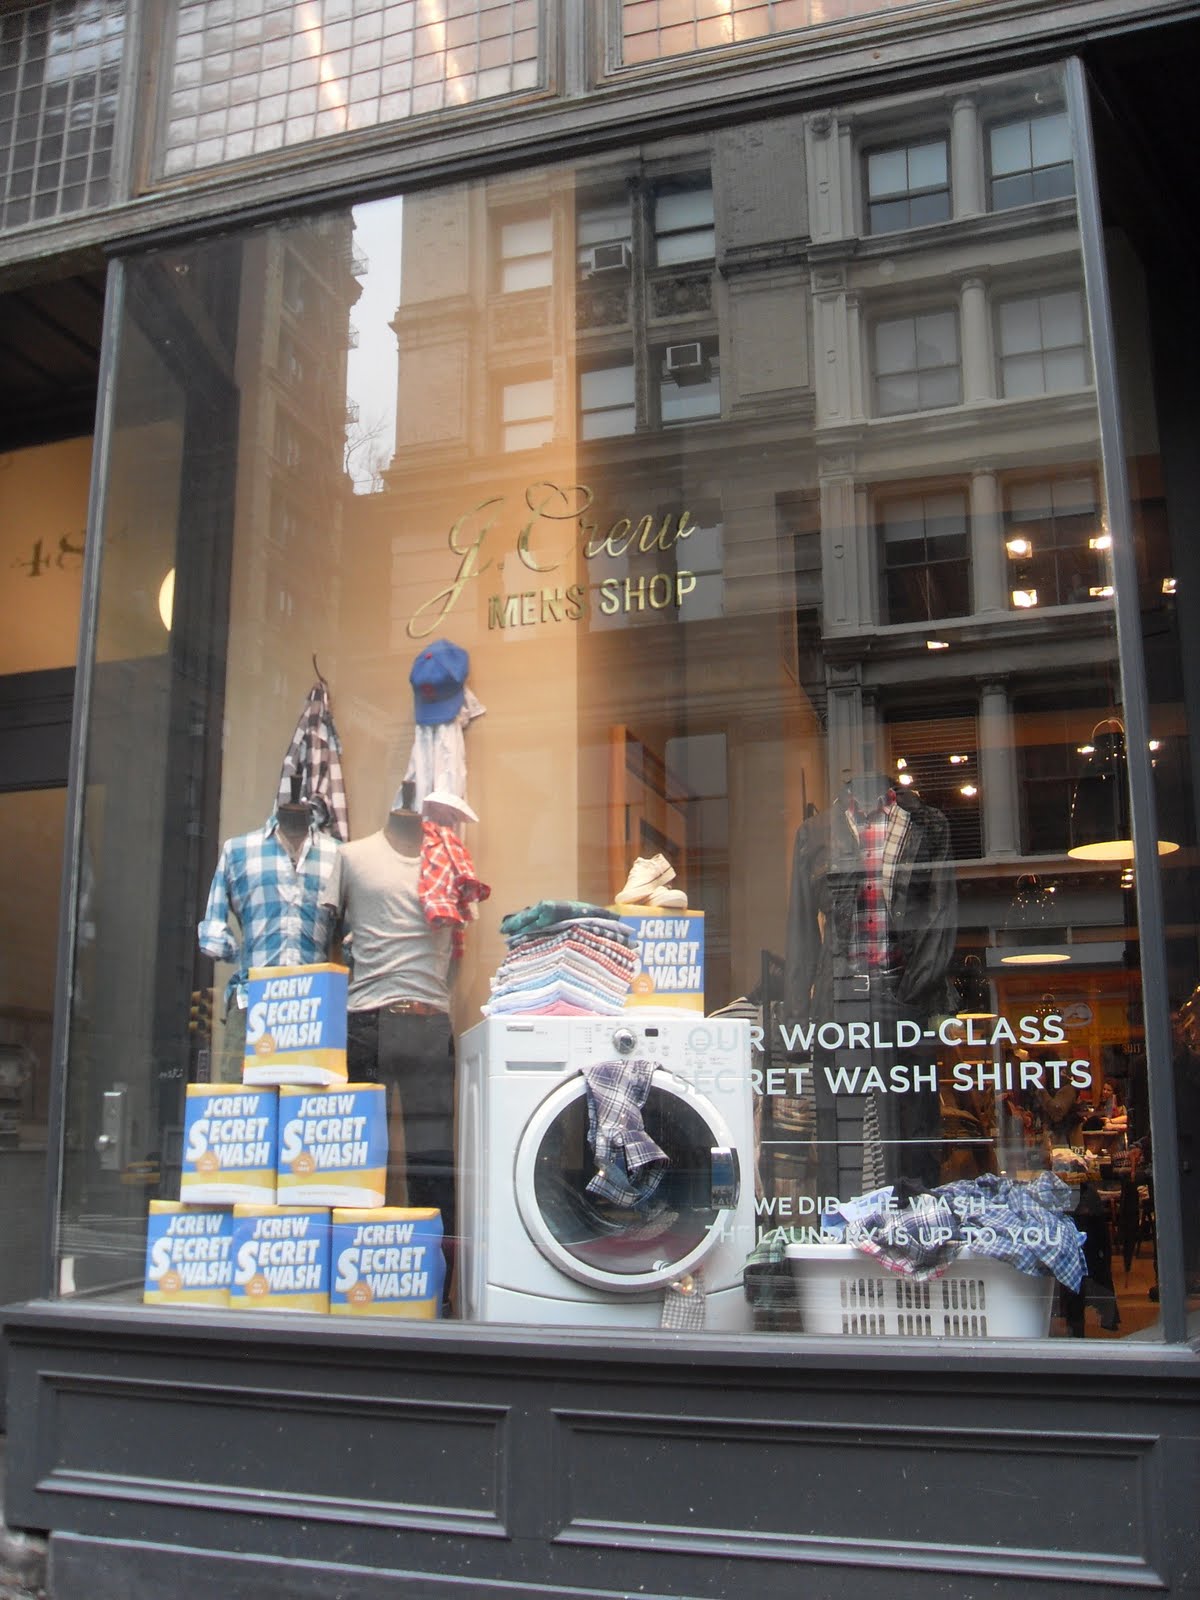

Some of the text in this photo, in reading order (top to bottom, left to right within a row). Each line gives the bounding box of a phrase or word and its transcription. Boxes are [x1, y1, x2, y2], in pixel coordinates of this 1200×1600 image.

[488, 570, 697, 629] MENS SHOP
[637, 919, 690, 939] JCREW
[262, 977, 312, 1001] JCREW
[648, 966, 701, 989] WASH
[246, 997, 321, 1045] SECRET
[688, 1025, 765, 1051] OUR
[779, 1015, 1065, 1051] WORLD-CLASS
[270, 1022, 322, 1048] WASH
[671, 1060, 1092, 1095] SECRET WASH SHIRTS
[204, 1096, 259, 1118] JCREW
[298, 1094, 355, 1117] JCREW
[186, 1117, 269, 1161] SECRET
[281, 1116, 367, 1161] SECRET
[213, 1141, 270, 1168] WASH
[310, 1141, 368, 1167] WASH
[754, 1197, 792, 1215] WE
[799, 1196, 840, 1215] DID
[850, 1196, 898, 1215] THE
[167, 1214, 223, 1235] JCREW
[253, 1217, 309, 1239] JCREW
[353, 1223, 414, 1246] JCREW
[757, 1226, 878, 1245] LAUNDRY
[888, 1227, 908, 1246] IS
[919, 1226, 953, 1246] UP
[960, 1226, 997, 1246] TO
[1007, 1226, 1062, 1246] YOU
[149, 1236, 233, 1281] SECRET
[234, 1239, 320, 1285] SECRET
[335, 1247, 425, 1292] SECRET
[177, 1261, 232, 1286] WASH
[264, 1264, 321, 1290] WASH
[367, 1272, 428, 1298] WASH
